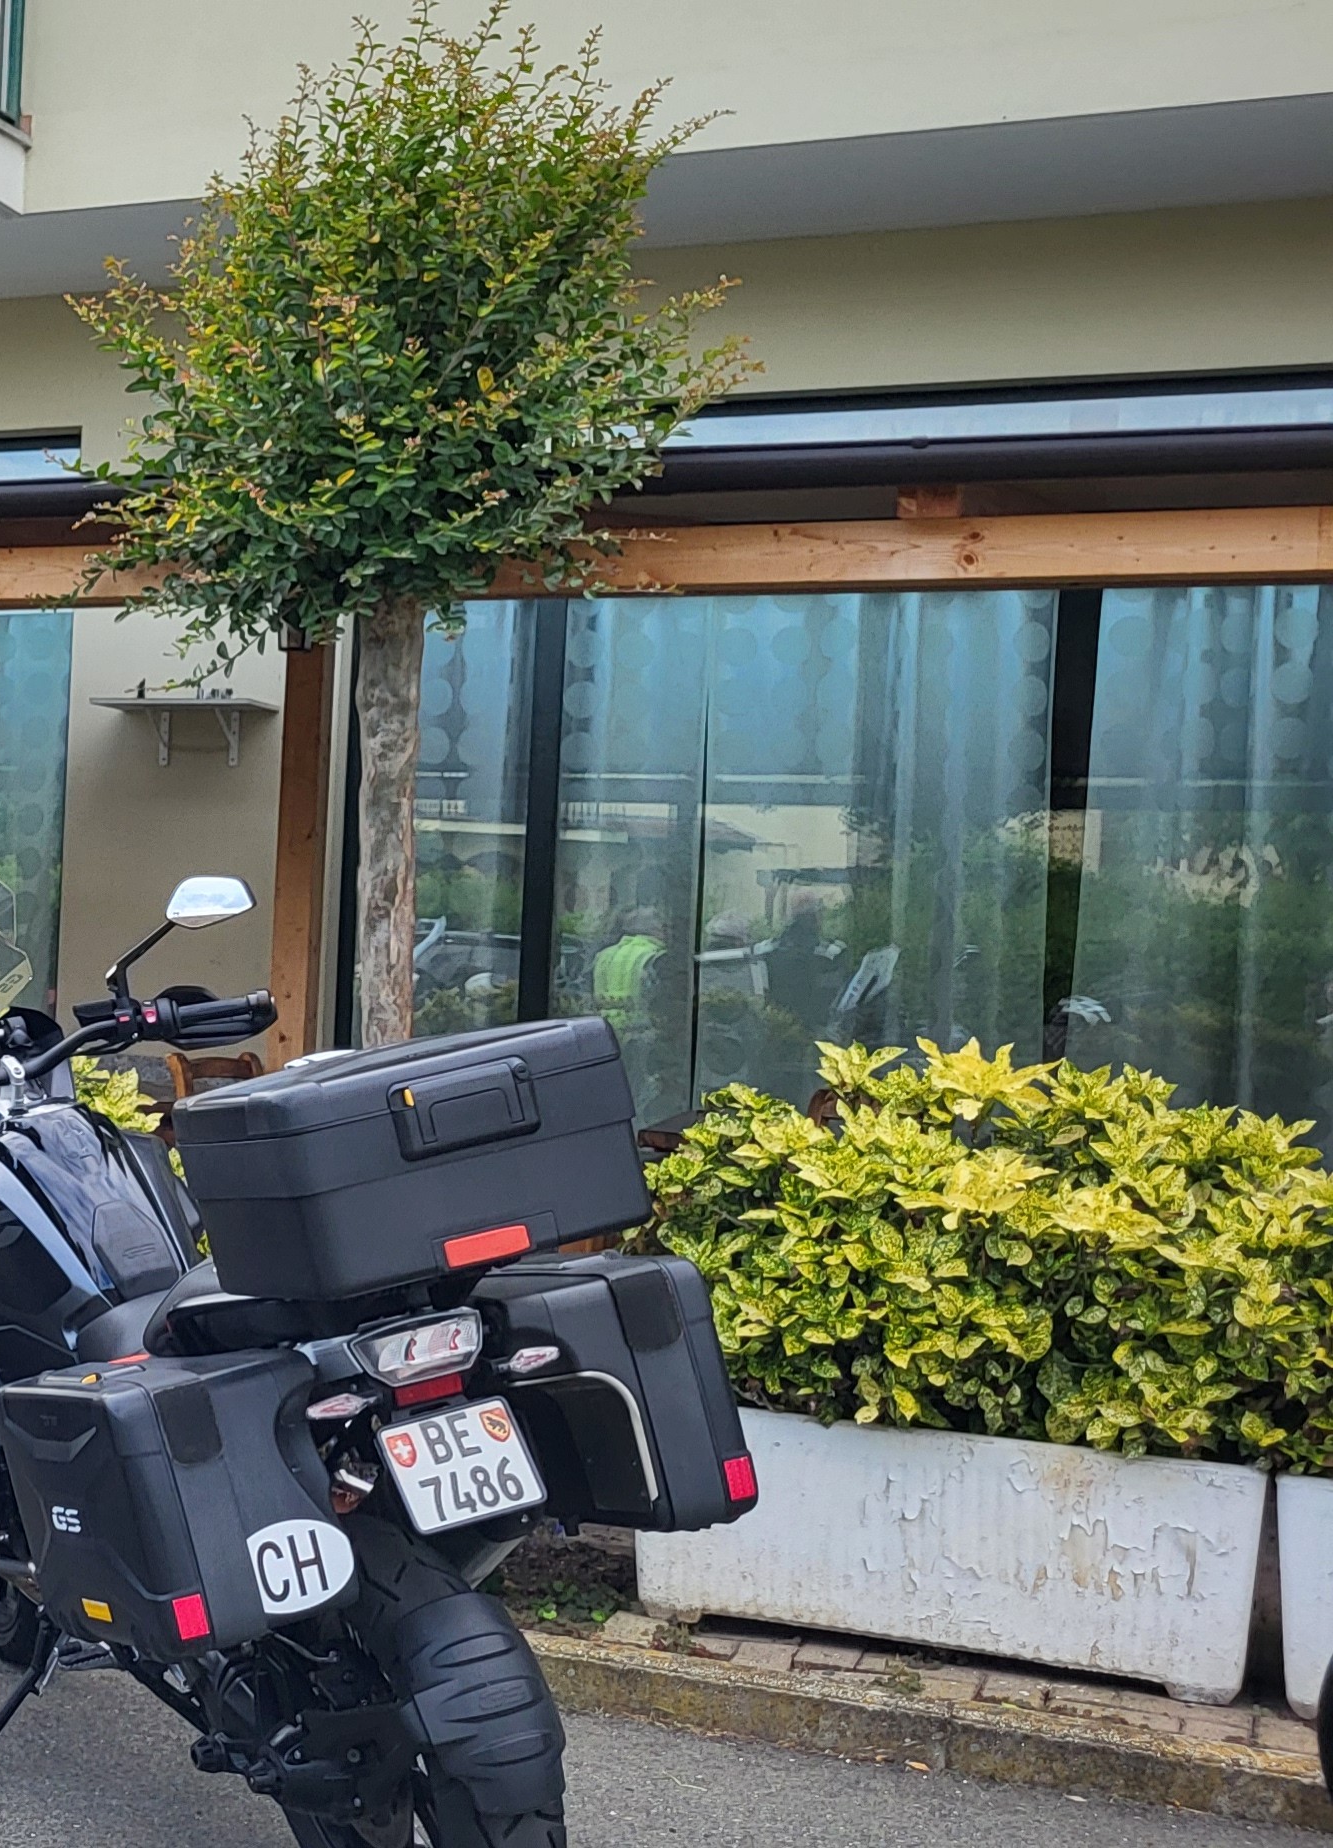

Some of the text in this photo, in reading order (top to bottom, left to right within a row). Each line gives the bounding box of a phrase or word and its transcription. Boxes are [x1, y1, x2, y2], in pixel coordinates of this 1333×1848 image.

[418, 1411, 483, 1466] BE
[51, 1505, 82, 1533] GS
[418, 1456, 525, 1522] 7486
[256, 1528, 330, 1603] CH
